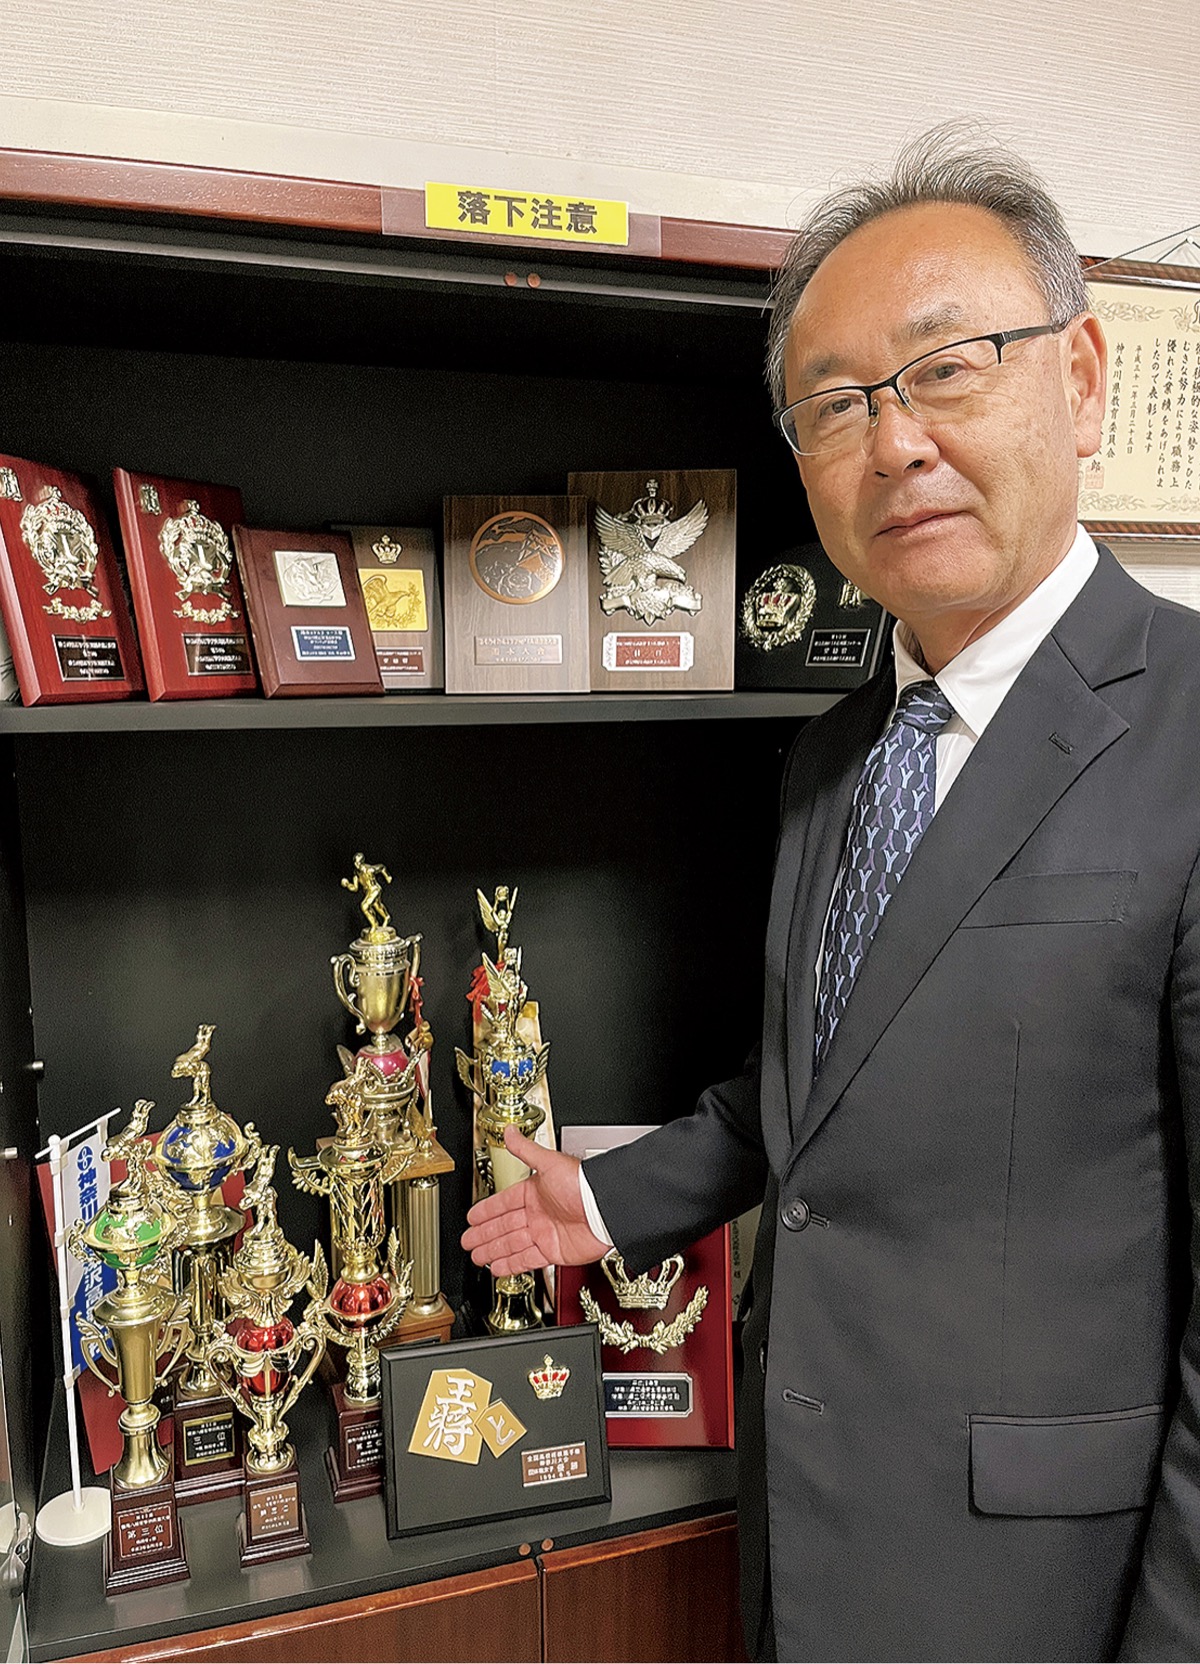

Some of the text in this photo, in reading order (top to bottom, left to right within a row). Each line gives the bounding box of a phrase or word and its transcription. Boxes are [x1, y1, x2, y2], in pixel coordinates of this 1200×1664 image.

[457, 190, 598, 234] 落下注意
[1106, 342, 1125, 459] 神奈川県教育委員会
[486, 1415, 515, 1445] と
